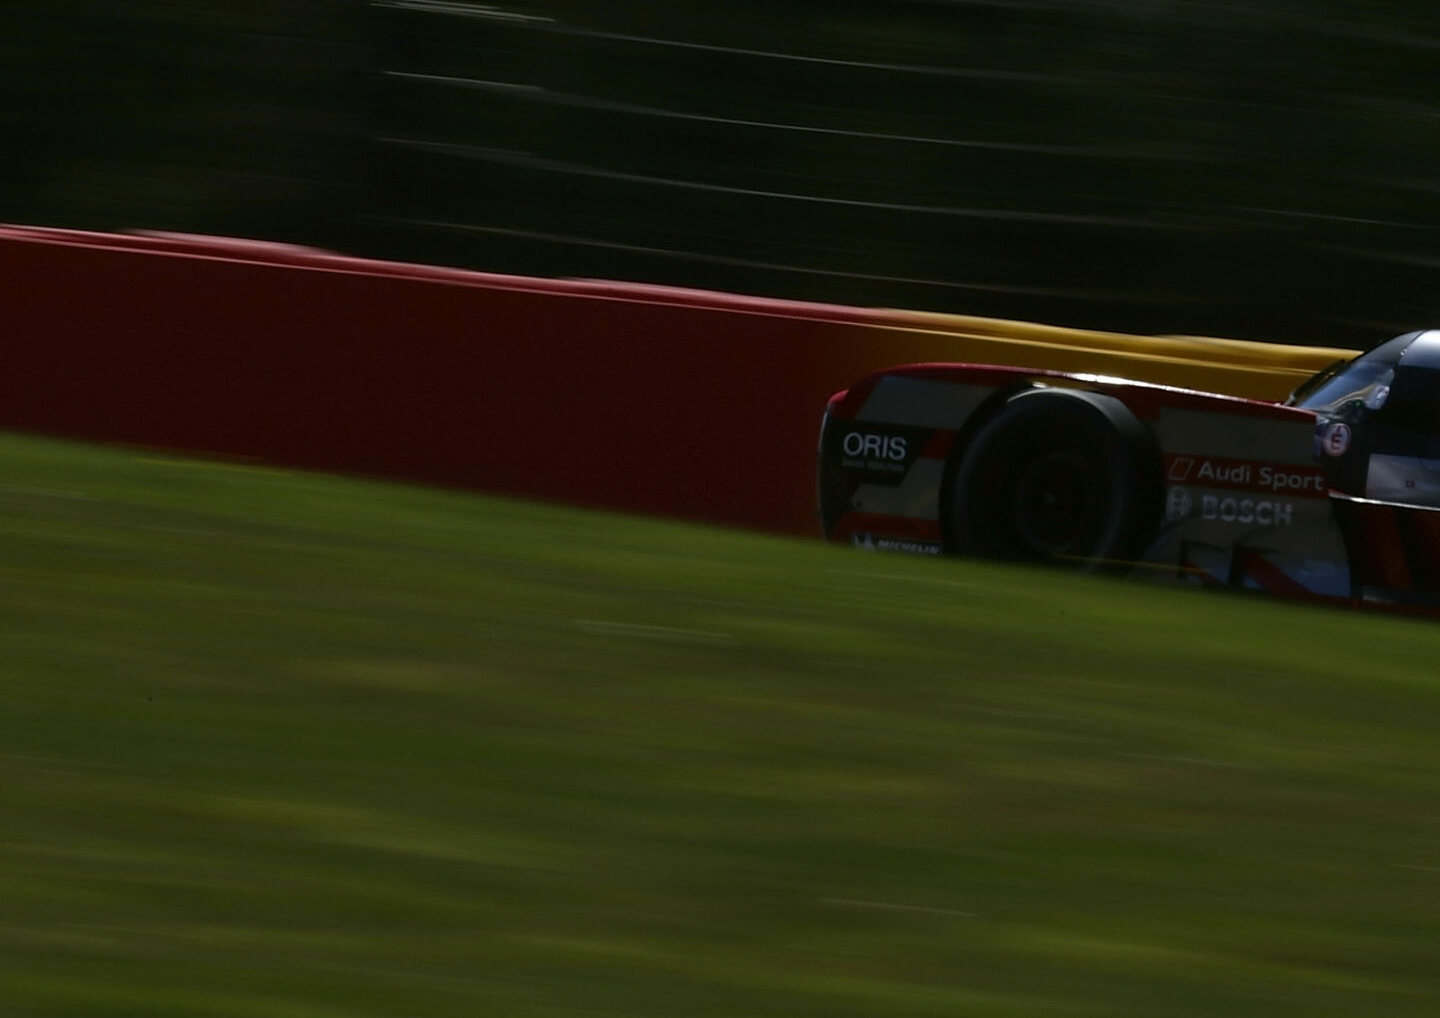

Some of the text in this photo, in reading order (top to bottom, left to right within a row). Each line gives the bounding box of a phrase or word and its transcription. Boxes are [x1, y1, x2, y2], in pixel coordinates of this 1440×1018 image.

[842, 431, 908, 461] ORIS
[1198, 461, 1324, 491] Audi Sport
[1201, 494, 1294, 527] BOSCH
